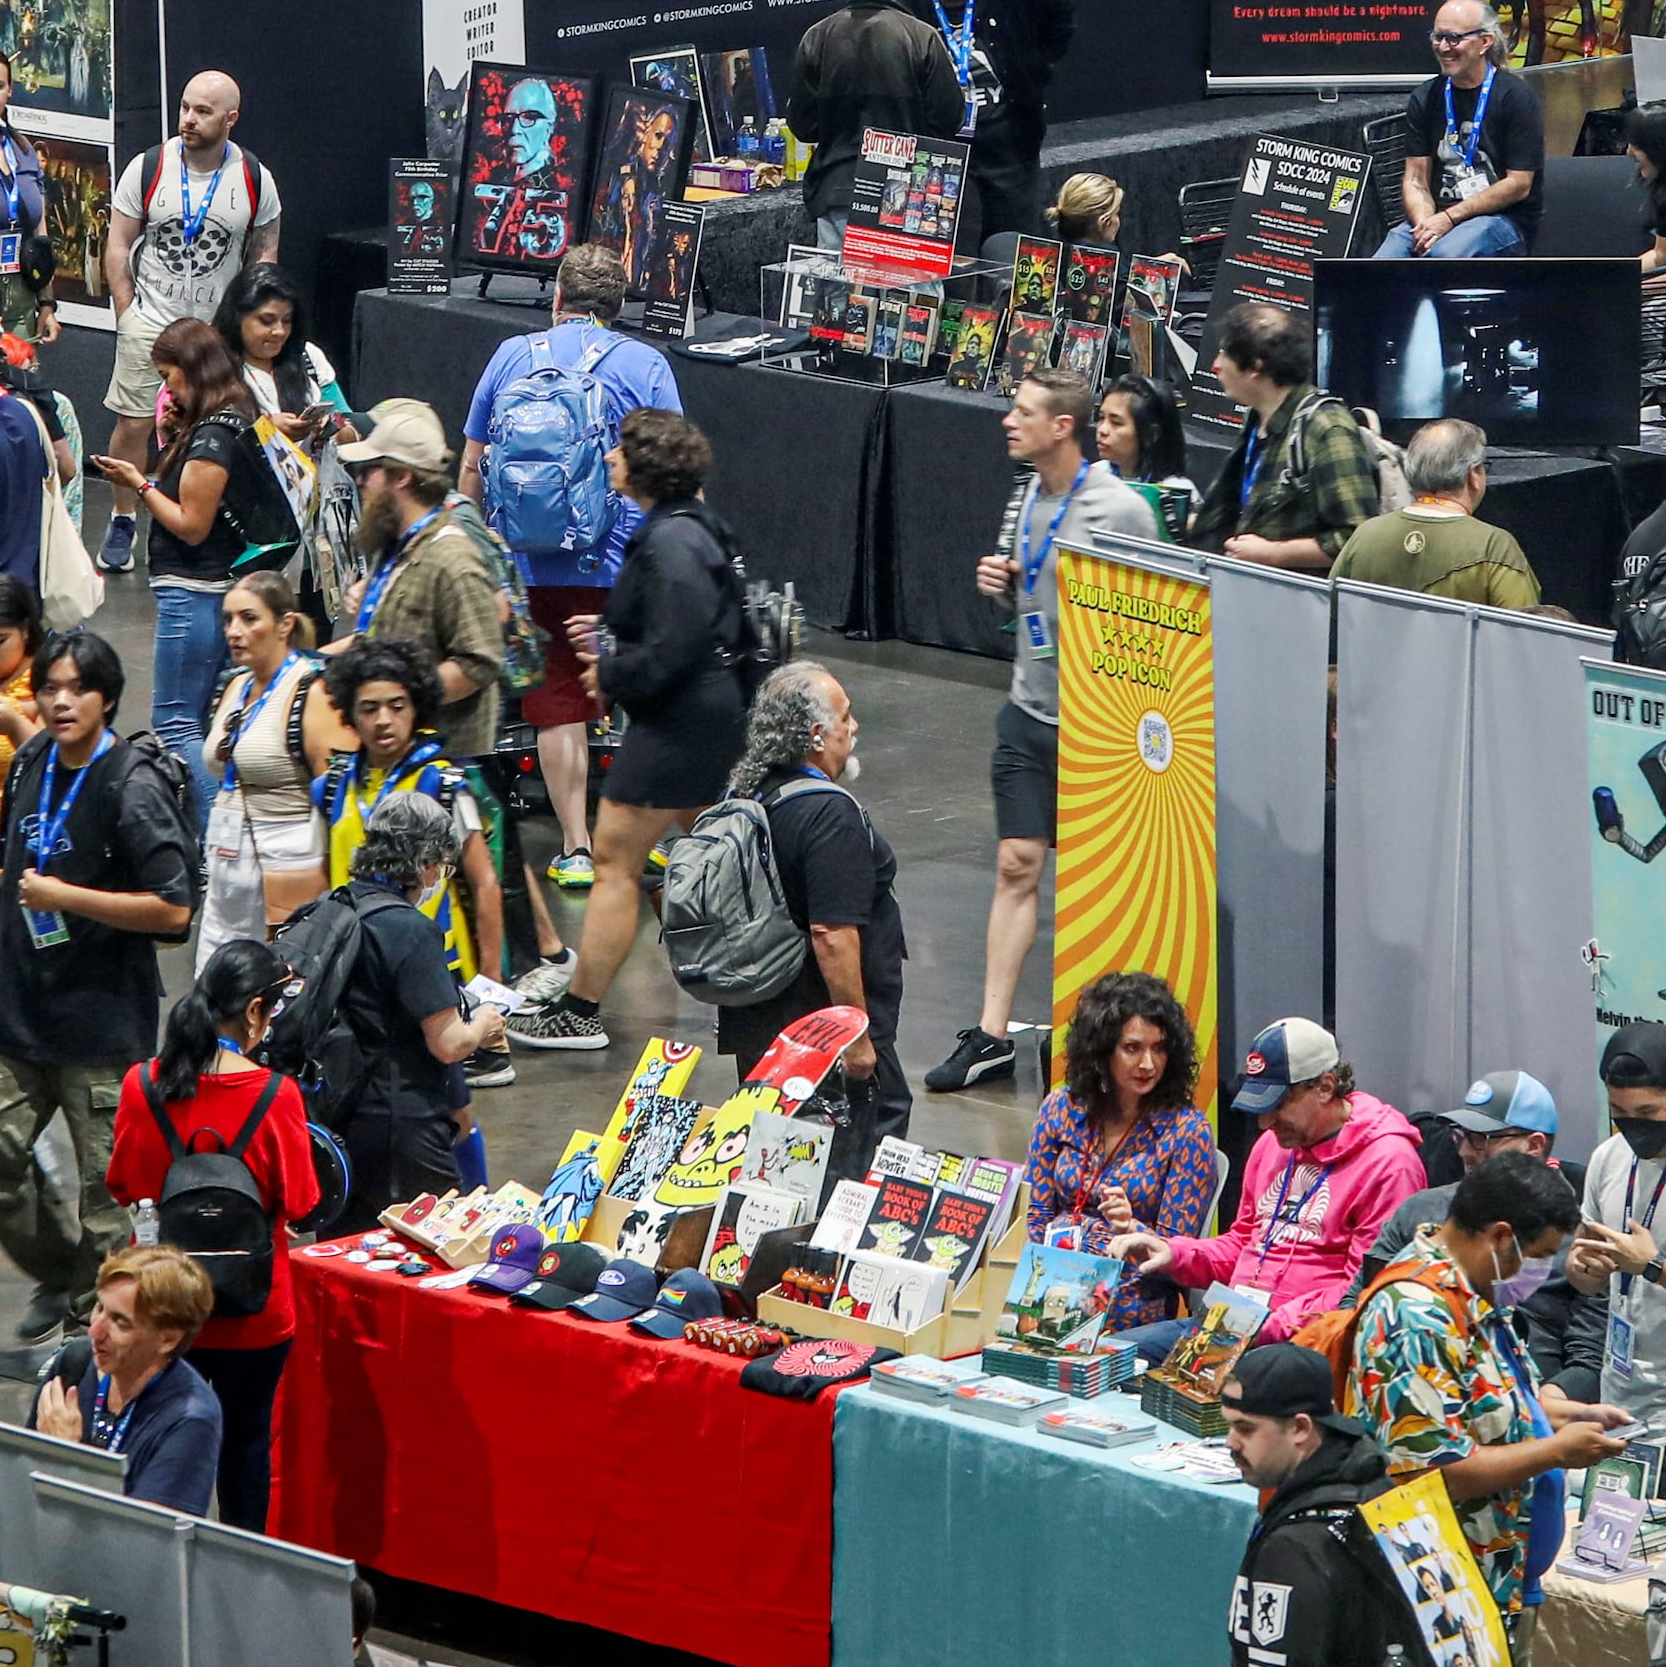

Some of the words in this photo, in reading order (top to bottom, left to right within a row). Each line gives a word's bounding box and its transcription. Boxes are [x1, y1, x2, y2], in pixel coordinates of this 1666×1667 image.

[464, 2, 497, 24] CREATOR
[566, 15, 647, 38] STORMKINGCOMICS
[662, 1, 754, 23] @STORMKINGCOMICS
[1234, 5, 1263, 20] Every
[1267, 5, 1300, 19] dream
[1305, 5, 1338, 19] should
[1343, 5, 1354, 19] be
[1370, 4, 1429, 20] nightmare.
[467, 23, 495, 41] WRITER
[1262, 28, 1401, 45] www.stormkingcomics.com
[467, 41, 495, 61] EDITOR
[863, 129, 893, 156] SUTTER
[894, 135, 917, 162] CANE
[474, 183, 571, 259] 75
[1069, 579, 1110, 613] PAUL
[1110, 590, 1202, 635] FRIEDRICH
[1092, 652, 1127, 679] POP
[1130, 660, 1172, 692] ICON
[1592, 690, 1635, 719] OUT
[1640, 699, 1666, 726] OF
[794, 1016, 851, 1053] EVIL
[883, 1191, 911, 1207] BOOK
[912, 1200, 926, 1211] OF
[939, 1206, 968, 1222] BOOK
[970, 1214, 984, 1225] OF
